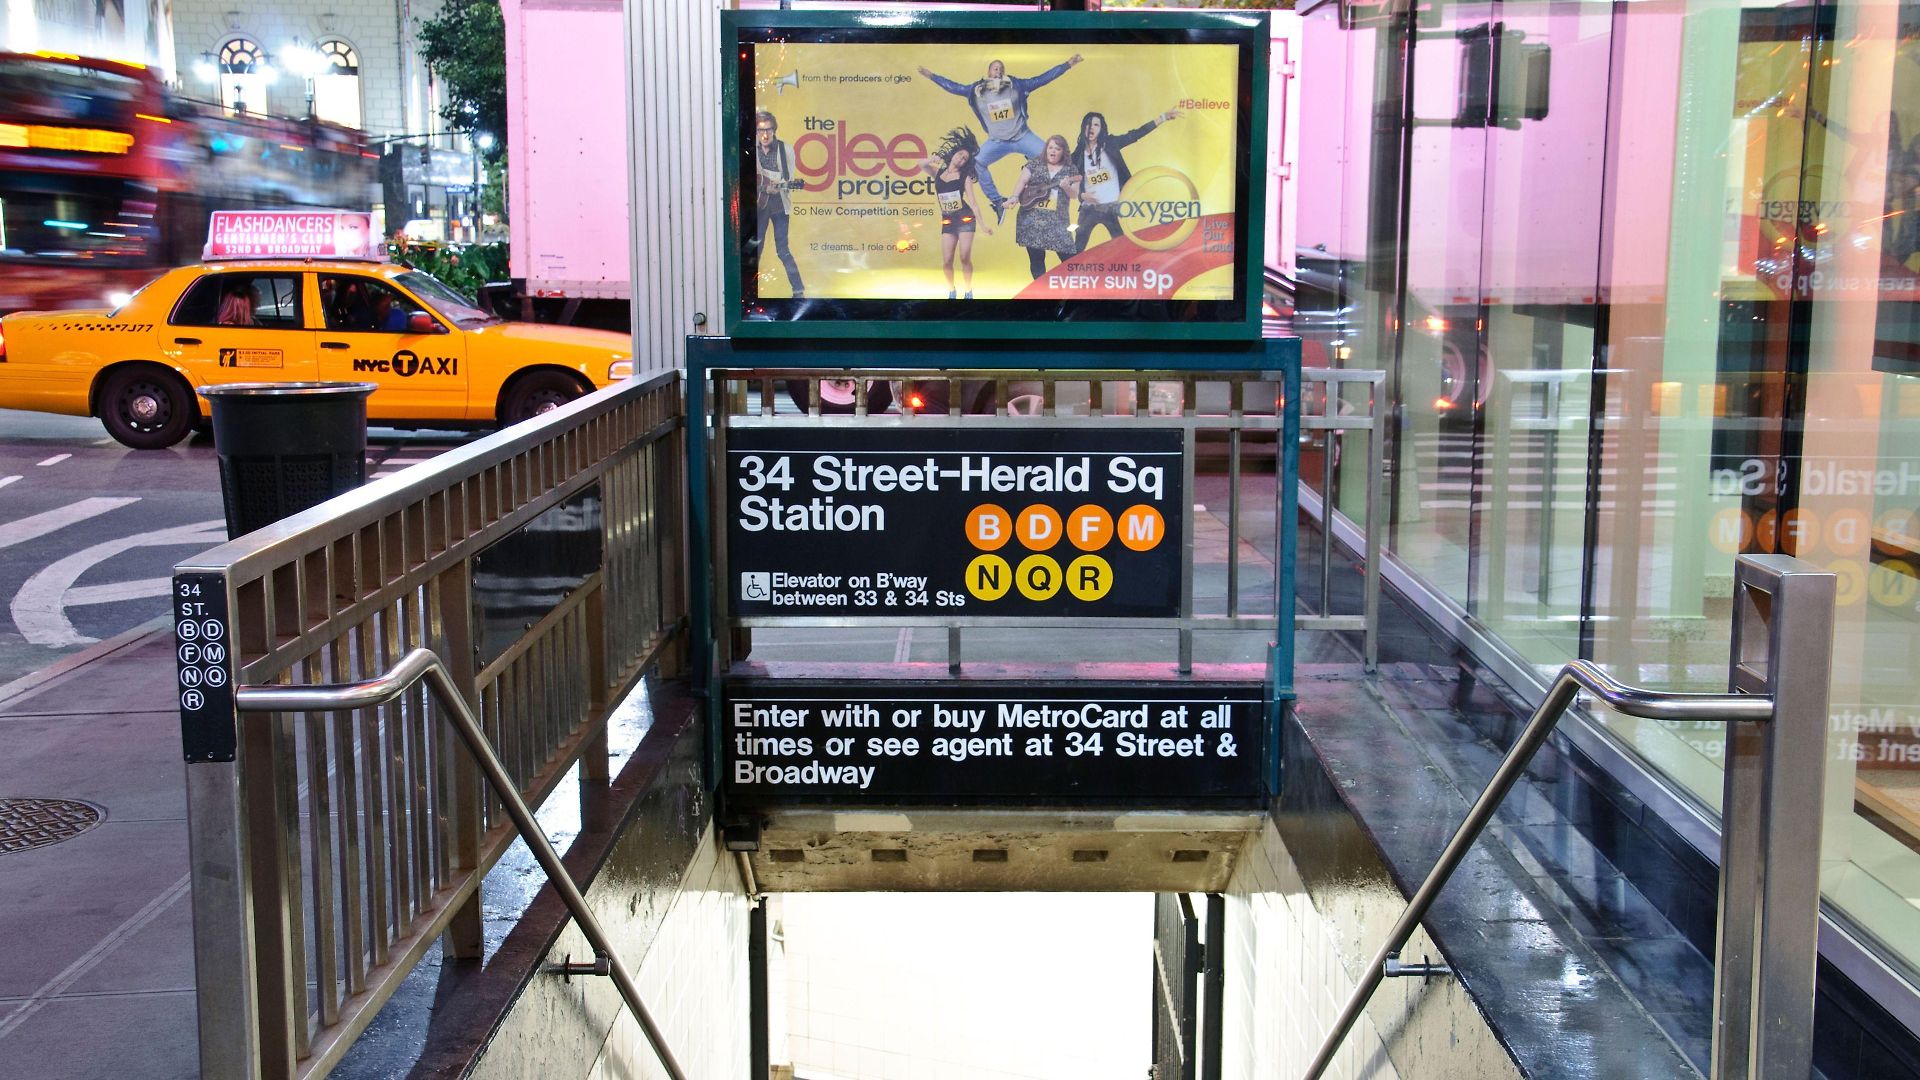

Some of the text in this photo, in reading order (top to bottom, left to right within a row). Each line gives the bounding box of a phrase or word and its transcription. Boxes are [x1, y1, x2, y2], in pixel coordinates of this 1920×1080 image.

[802, 74, 821, 83] from
[823, 74, 837, 83] the
[839, 74, 882, 85] producers
[884, 74, 894, 83] of
[1178, 99, 1230, 110] #Believe
[993, 109, 1009, 121] 147
[804, 116, 835, 131] the
[793, 120, 928, 193] glee
[1090, 172, 1109, 185] 933
[838, 175, 936, 199] project
[793, 206, 934, 219] So New Competition Series
[1118, 200, 1201, 225] oxygen
[216, 216, 333, 233] FLASHDANCERS
[302, 233, 332, 244] CLUB
[225, 244, 251, 255] 52ND
[267, 244, 322, 255] BROADWAY
[810, 243, 819, 251] 12
[867, 243, 884, 251] role
[1067, 263, 1141, 272] STARTS JUN 12
[1049, 269, 1174, 295] EVERY SUN 9p
[353, 350, 458, 377] NYC TAXI
[738, 455, 795, 492] 34
[1107, 456, 1164, 500] Sq
[739, 495, 885, 532] Station
[979, 514, 1155, 542] B D F M
[772, 572, 928, 592] Elevator on B'way
[978, 564, 1101, 593] N Q R
[180, 583, 201, 597] 34
[772, 589, 966, 607] between 33 & 34 Sts
[182, 602, 209, 616] ST.
[183, 623, 219, 637] B D
[184, 647, 221, 660] F M
[186, 670, 222, 684] N Q
[187, 693, 199, 707] R
[734, 703, 1231, 733] Enter with or buy MetroCard at all
[734, 731, 1238, 762] times or see agent at 34 Street &
[735, 760, 876, 789] Broadway
